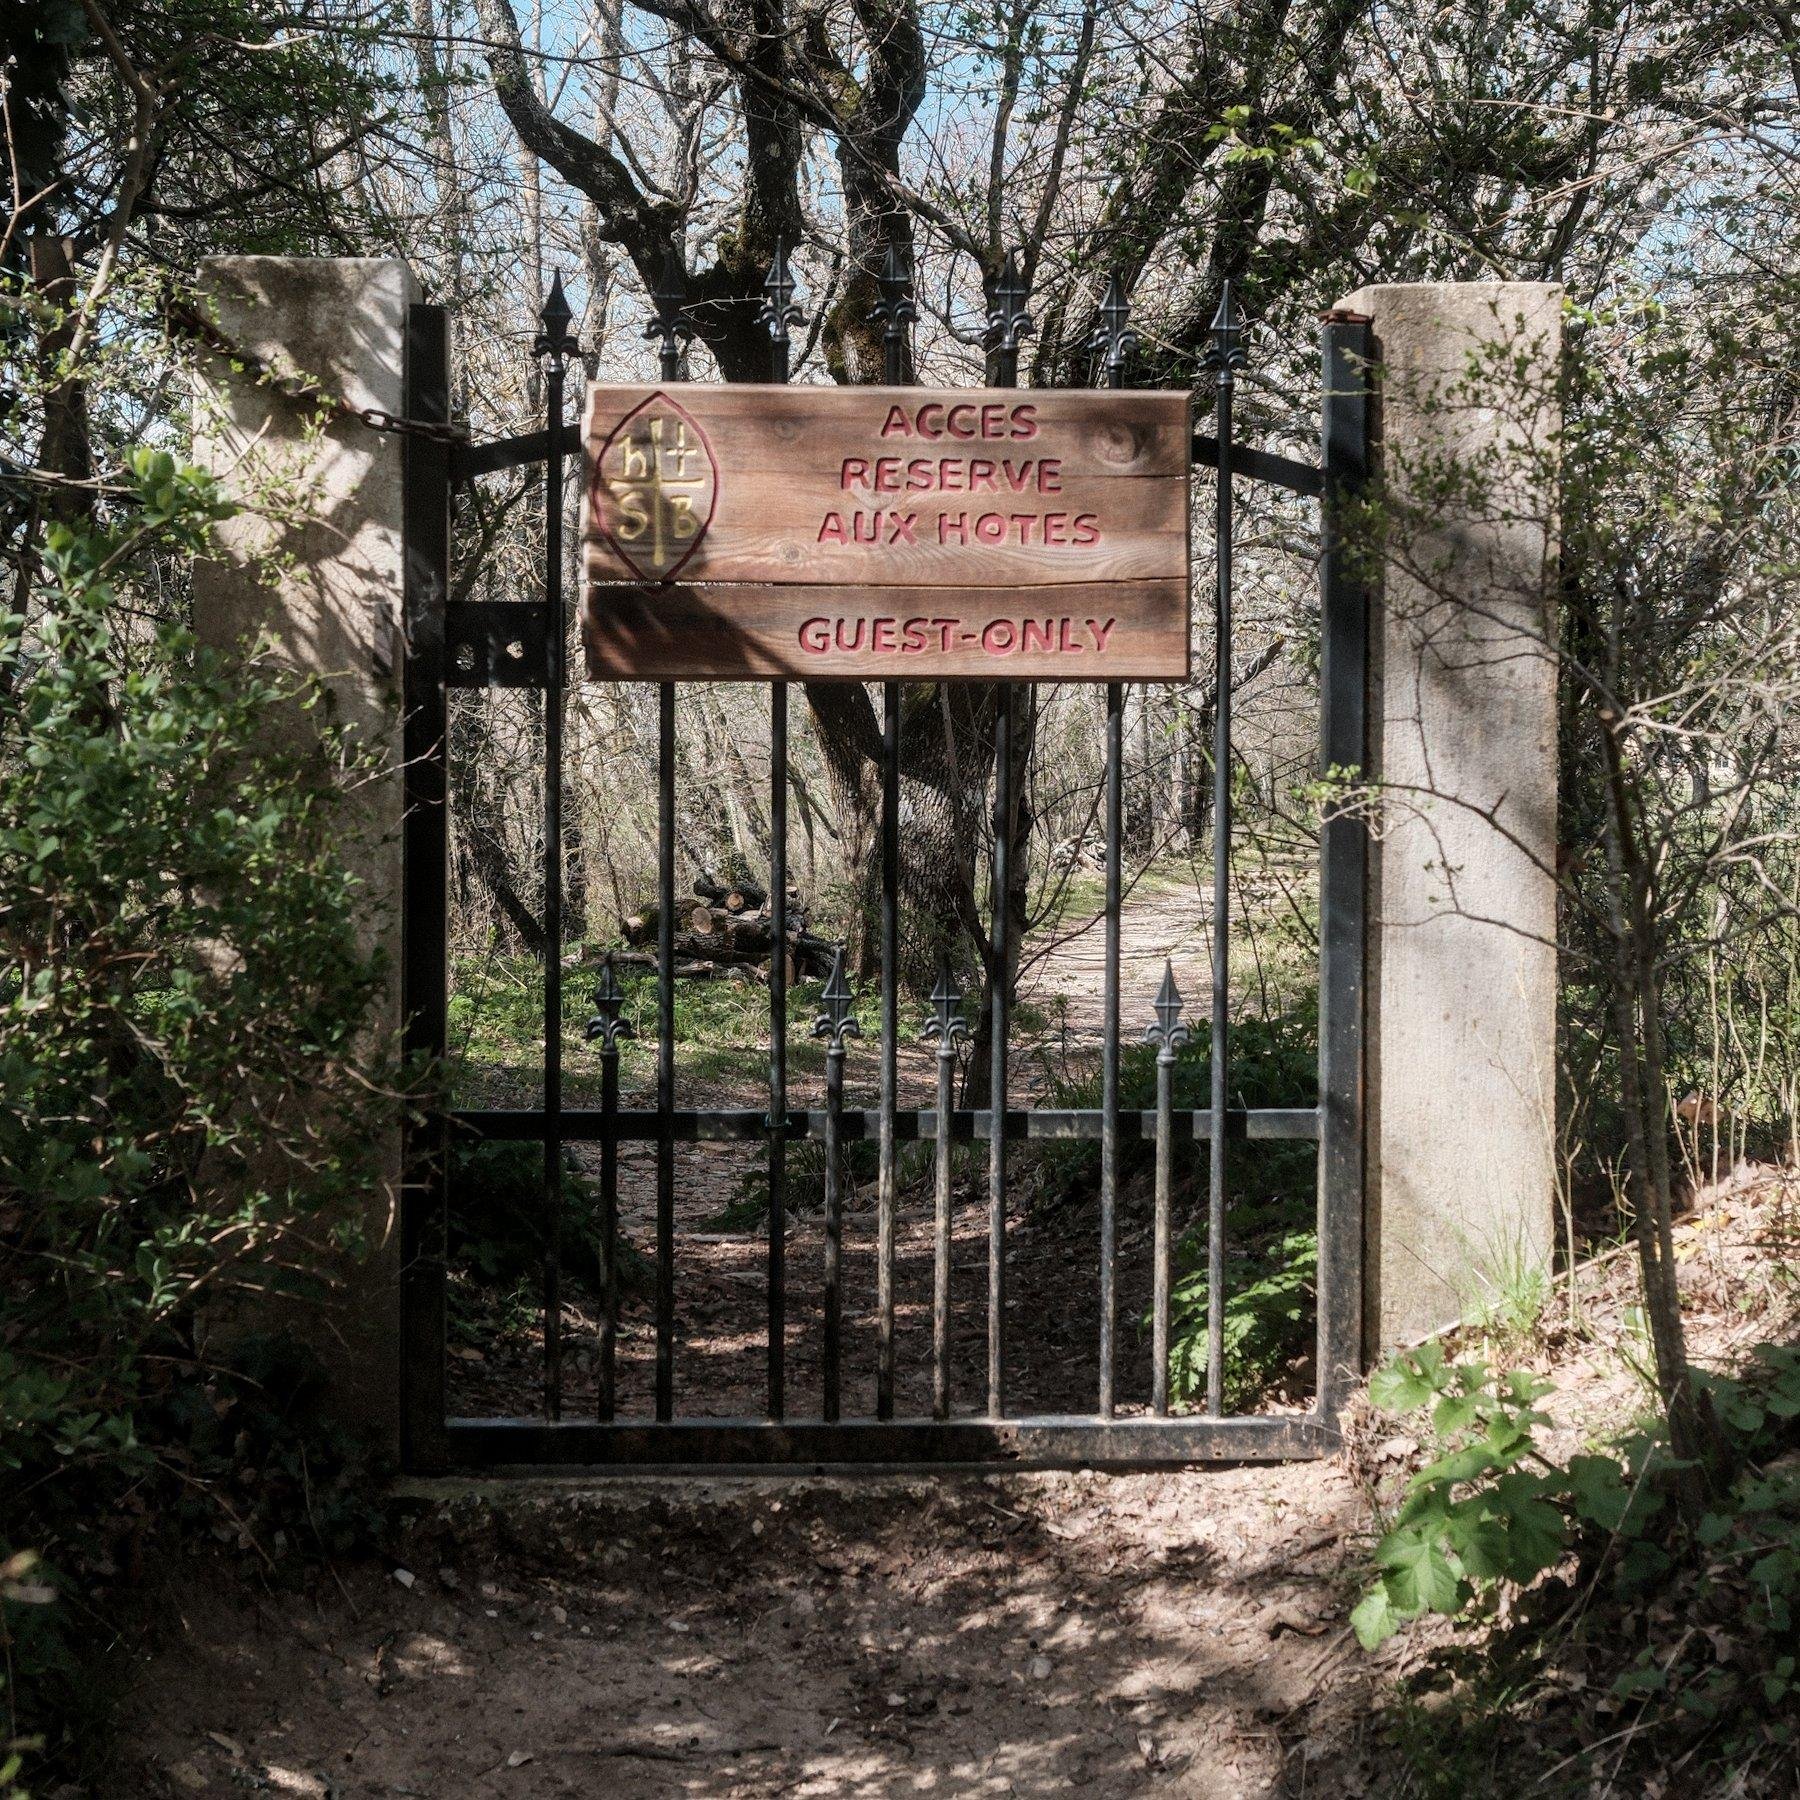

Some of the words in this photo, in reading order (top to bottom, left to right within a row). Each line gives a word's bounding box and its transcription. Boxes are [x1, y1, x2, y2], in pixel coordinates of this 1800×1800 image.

[880, 403, 1039, 440] ACCES
[840, 457, 1063, 494] RESERVE
[817, 511, 918, 546] AUX
[938, 511, 1101, 547] HOTES
[798, 617, 1116, 655] GUEST-ONLY
